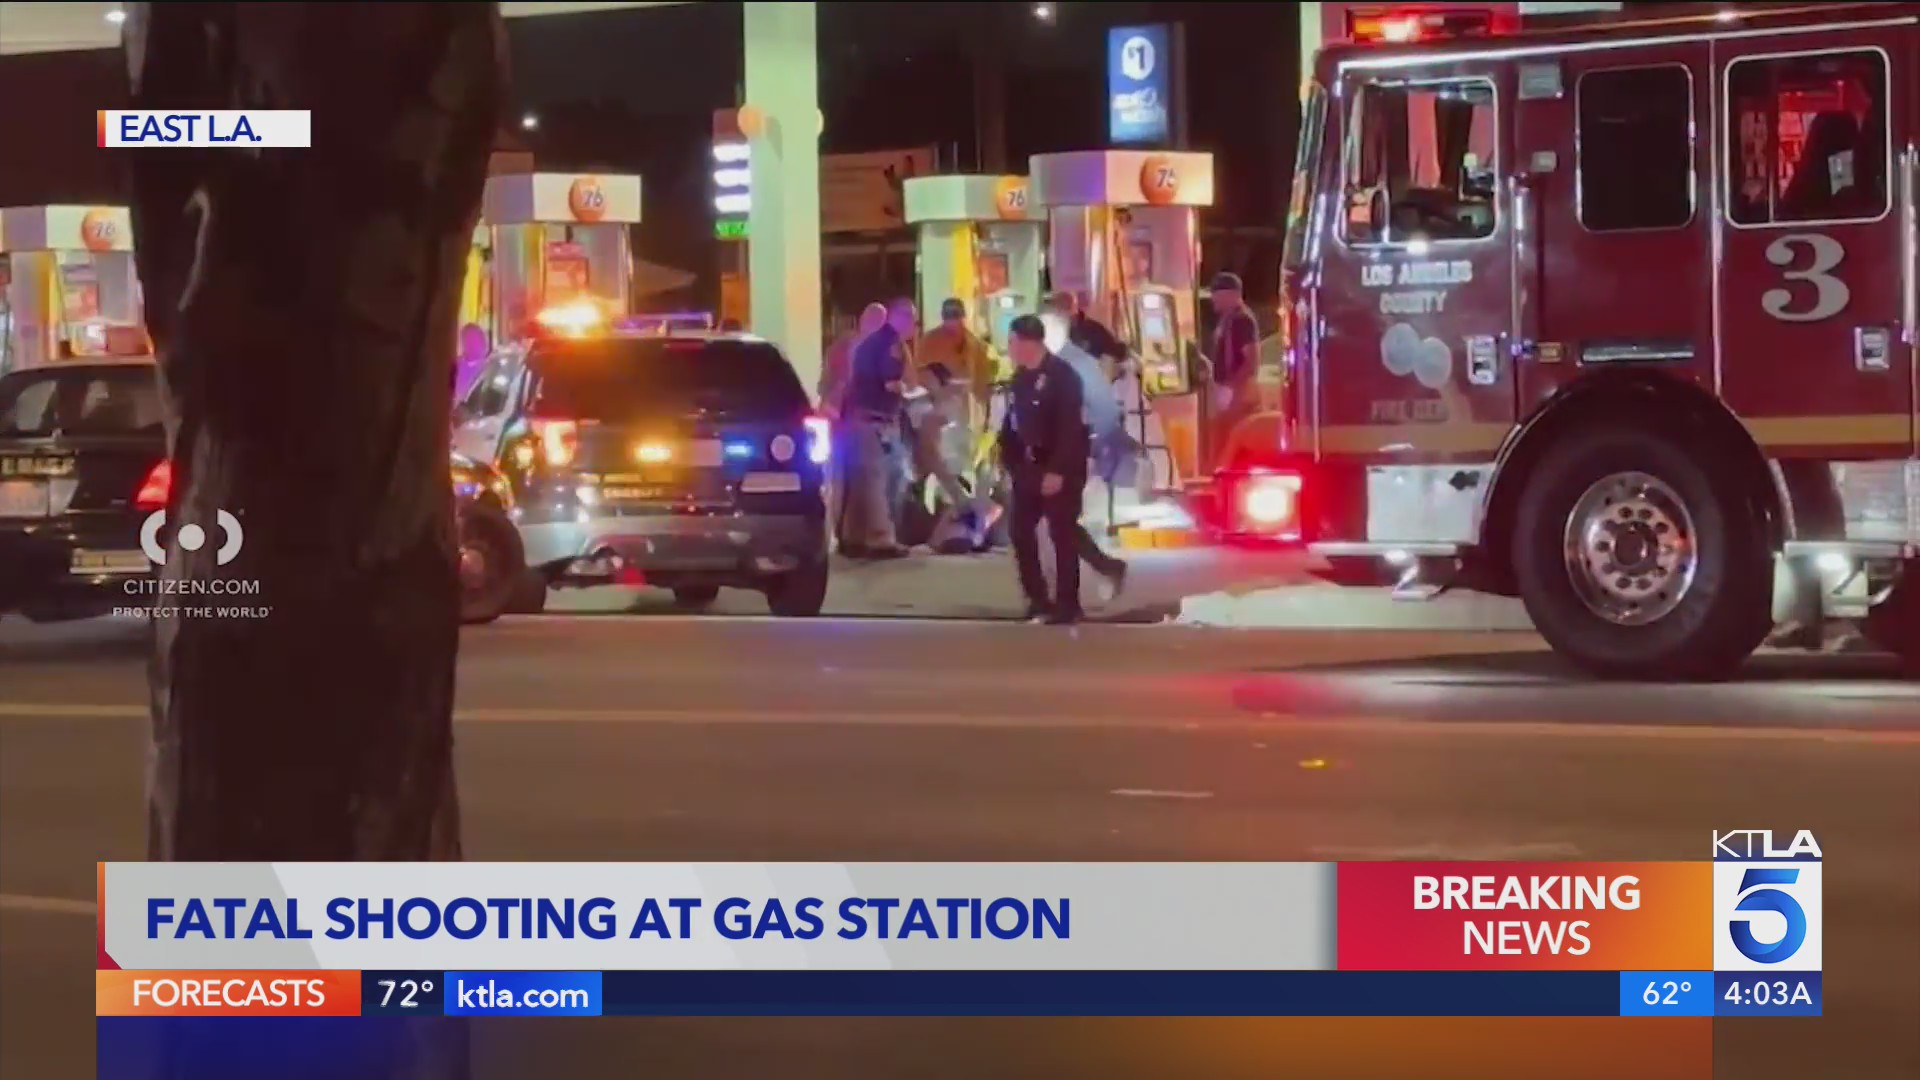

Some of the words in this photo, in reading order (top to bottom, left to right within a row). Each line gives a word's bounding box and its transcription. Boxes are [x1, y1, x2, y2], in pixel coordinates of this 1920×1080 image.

[582, 186, 604, 208] 76
[1007, 190, 1026, 207] 76
[1361, 264, 1394, 287] LOS
[1761, 233, 1850, 322] 3
